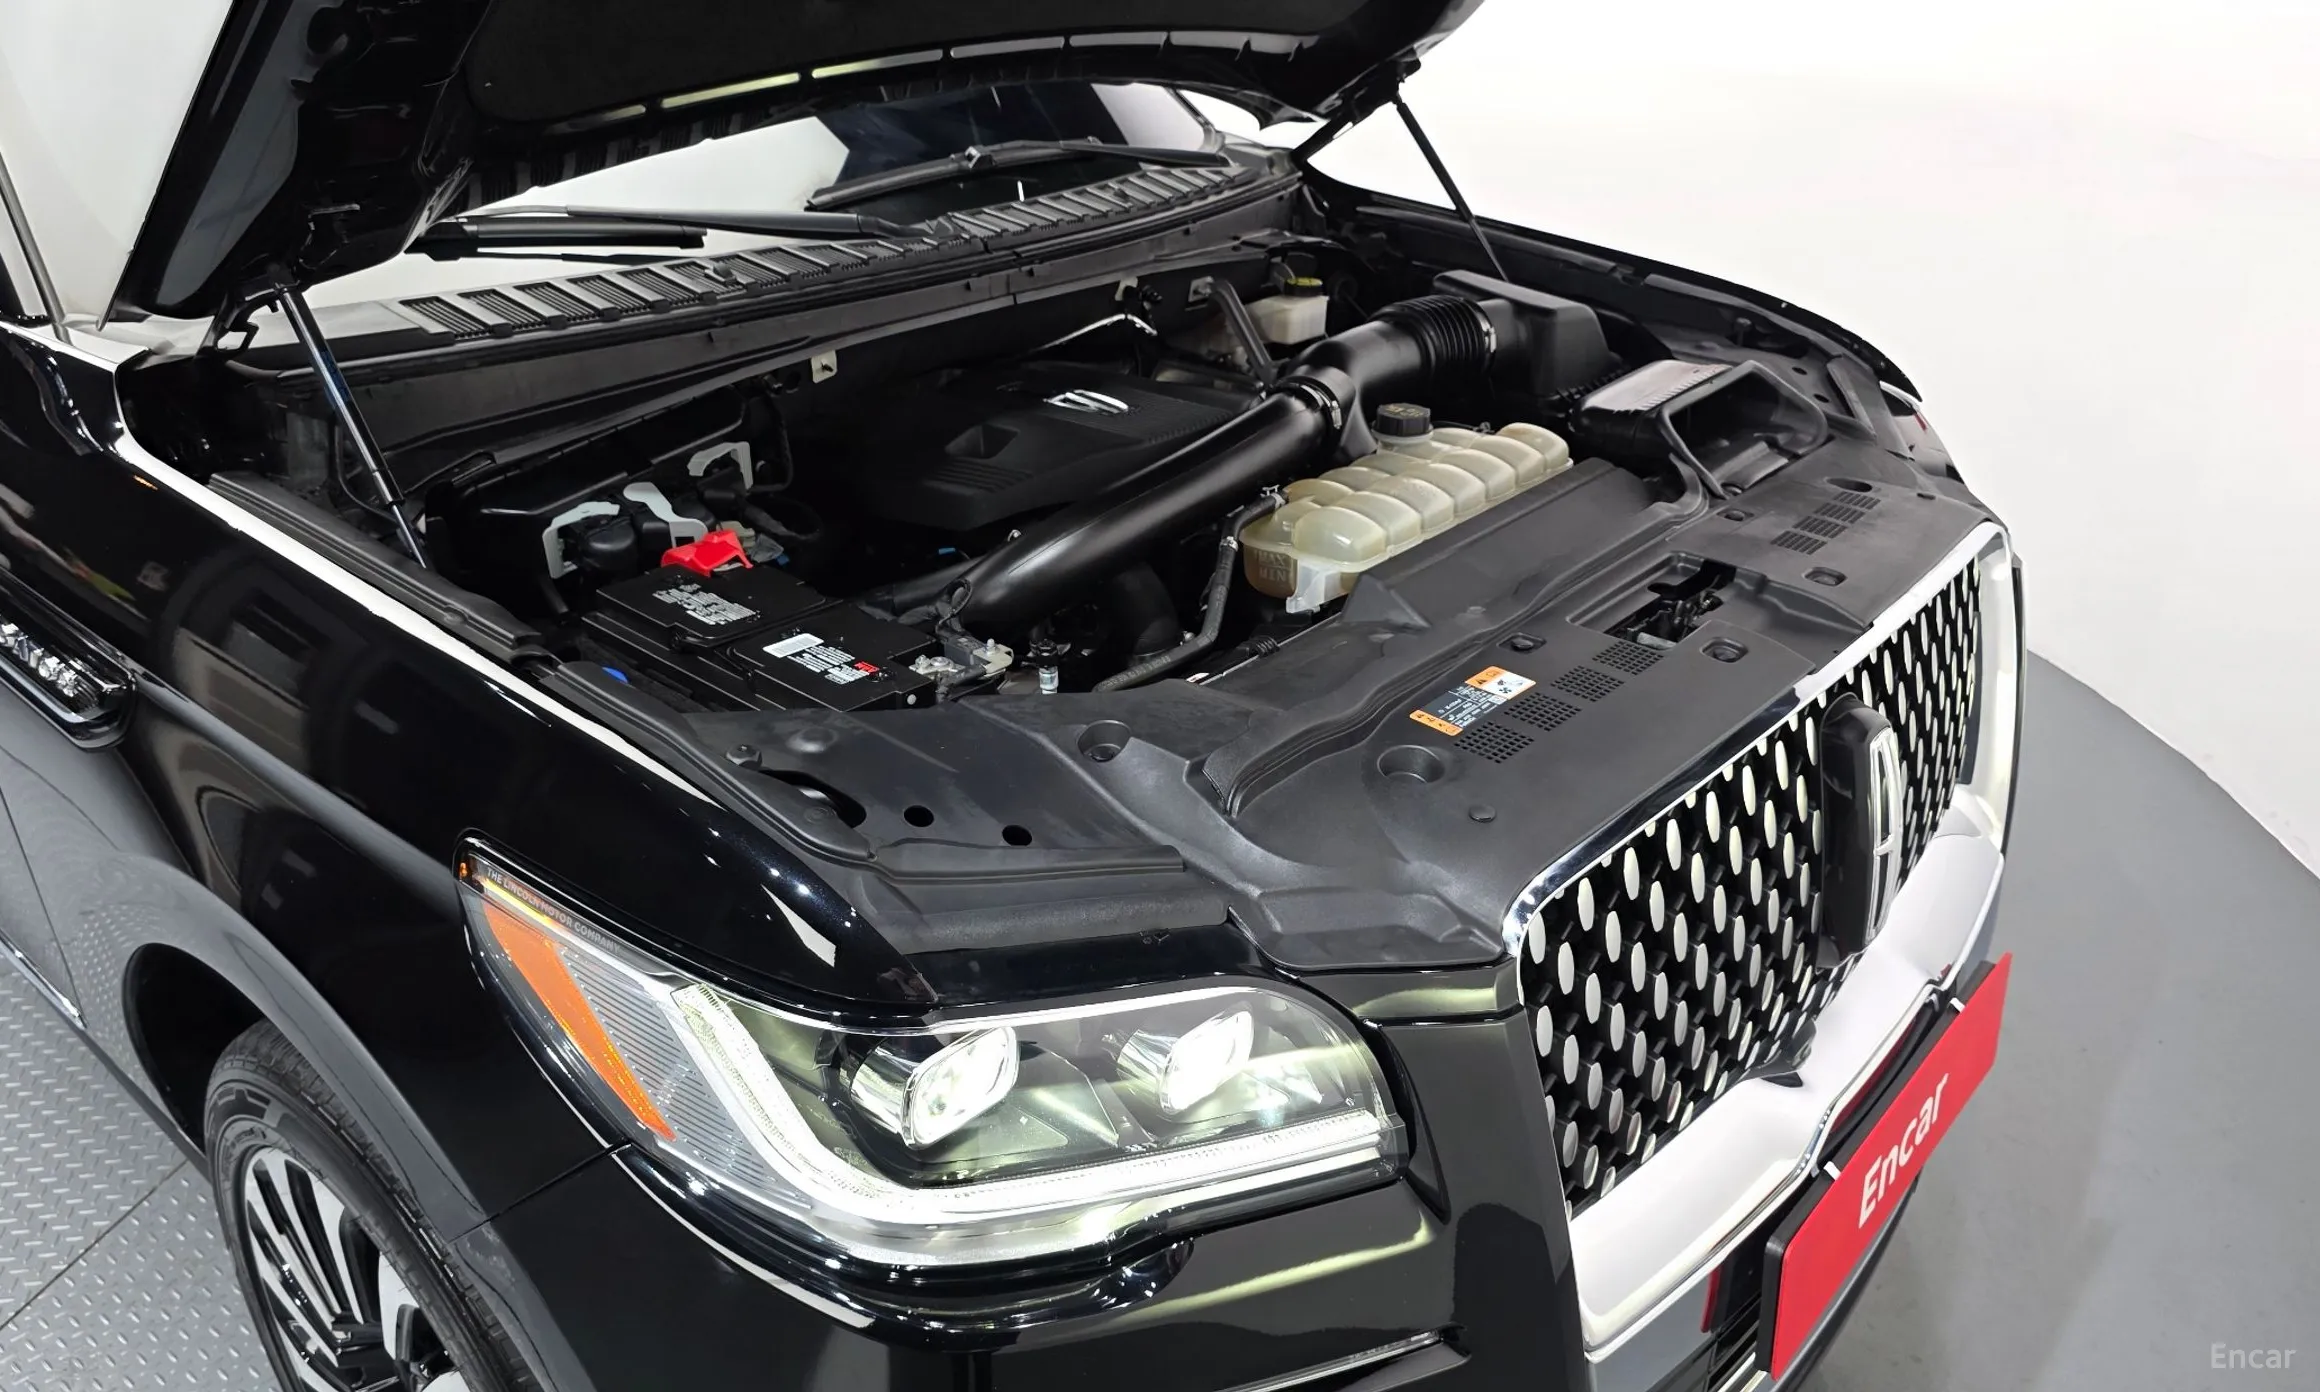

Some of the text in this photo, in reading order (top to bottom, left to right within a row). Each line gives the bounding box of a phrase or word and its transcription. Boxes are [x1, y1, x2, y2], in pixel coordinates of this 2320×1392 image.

[487, 868, 622, 953] THE LINCOLN MOTOR COMPANY
[1858, 1072, 1950, 1229] Encar
